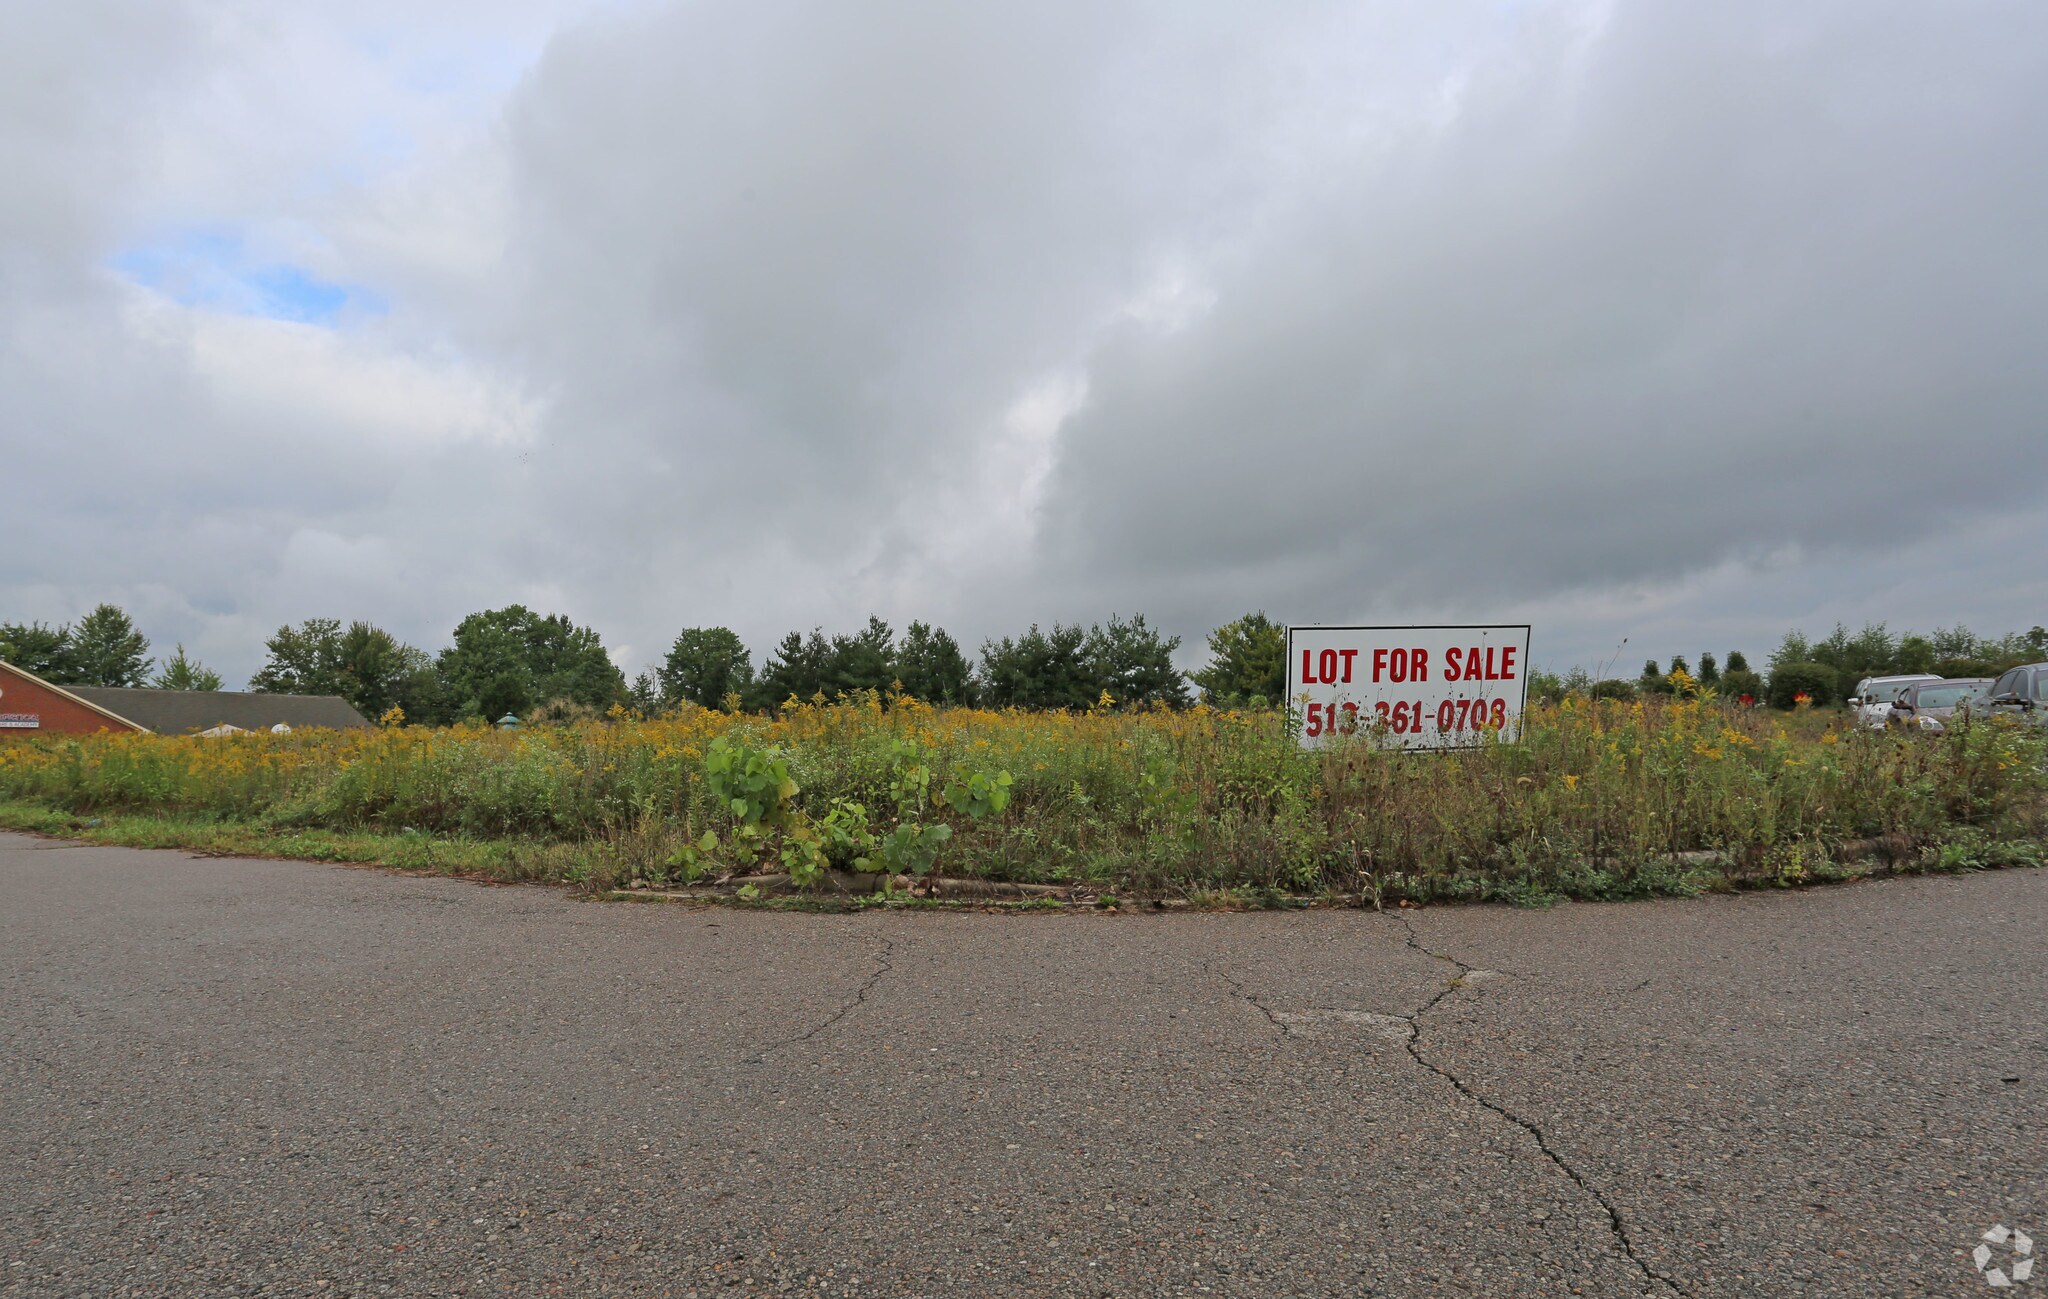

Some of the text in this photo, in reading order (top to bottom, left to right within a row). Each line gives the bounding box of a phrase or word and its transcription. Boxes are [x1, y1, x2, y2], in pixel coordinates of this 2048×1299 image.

[1302, 647, 1517, 684] LOT FOR SALE
